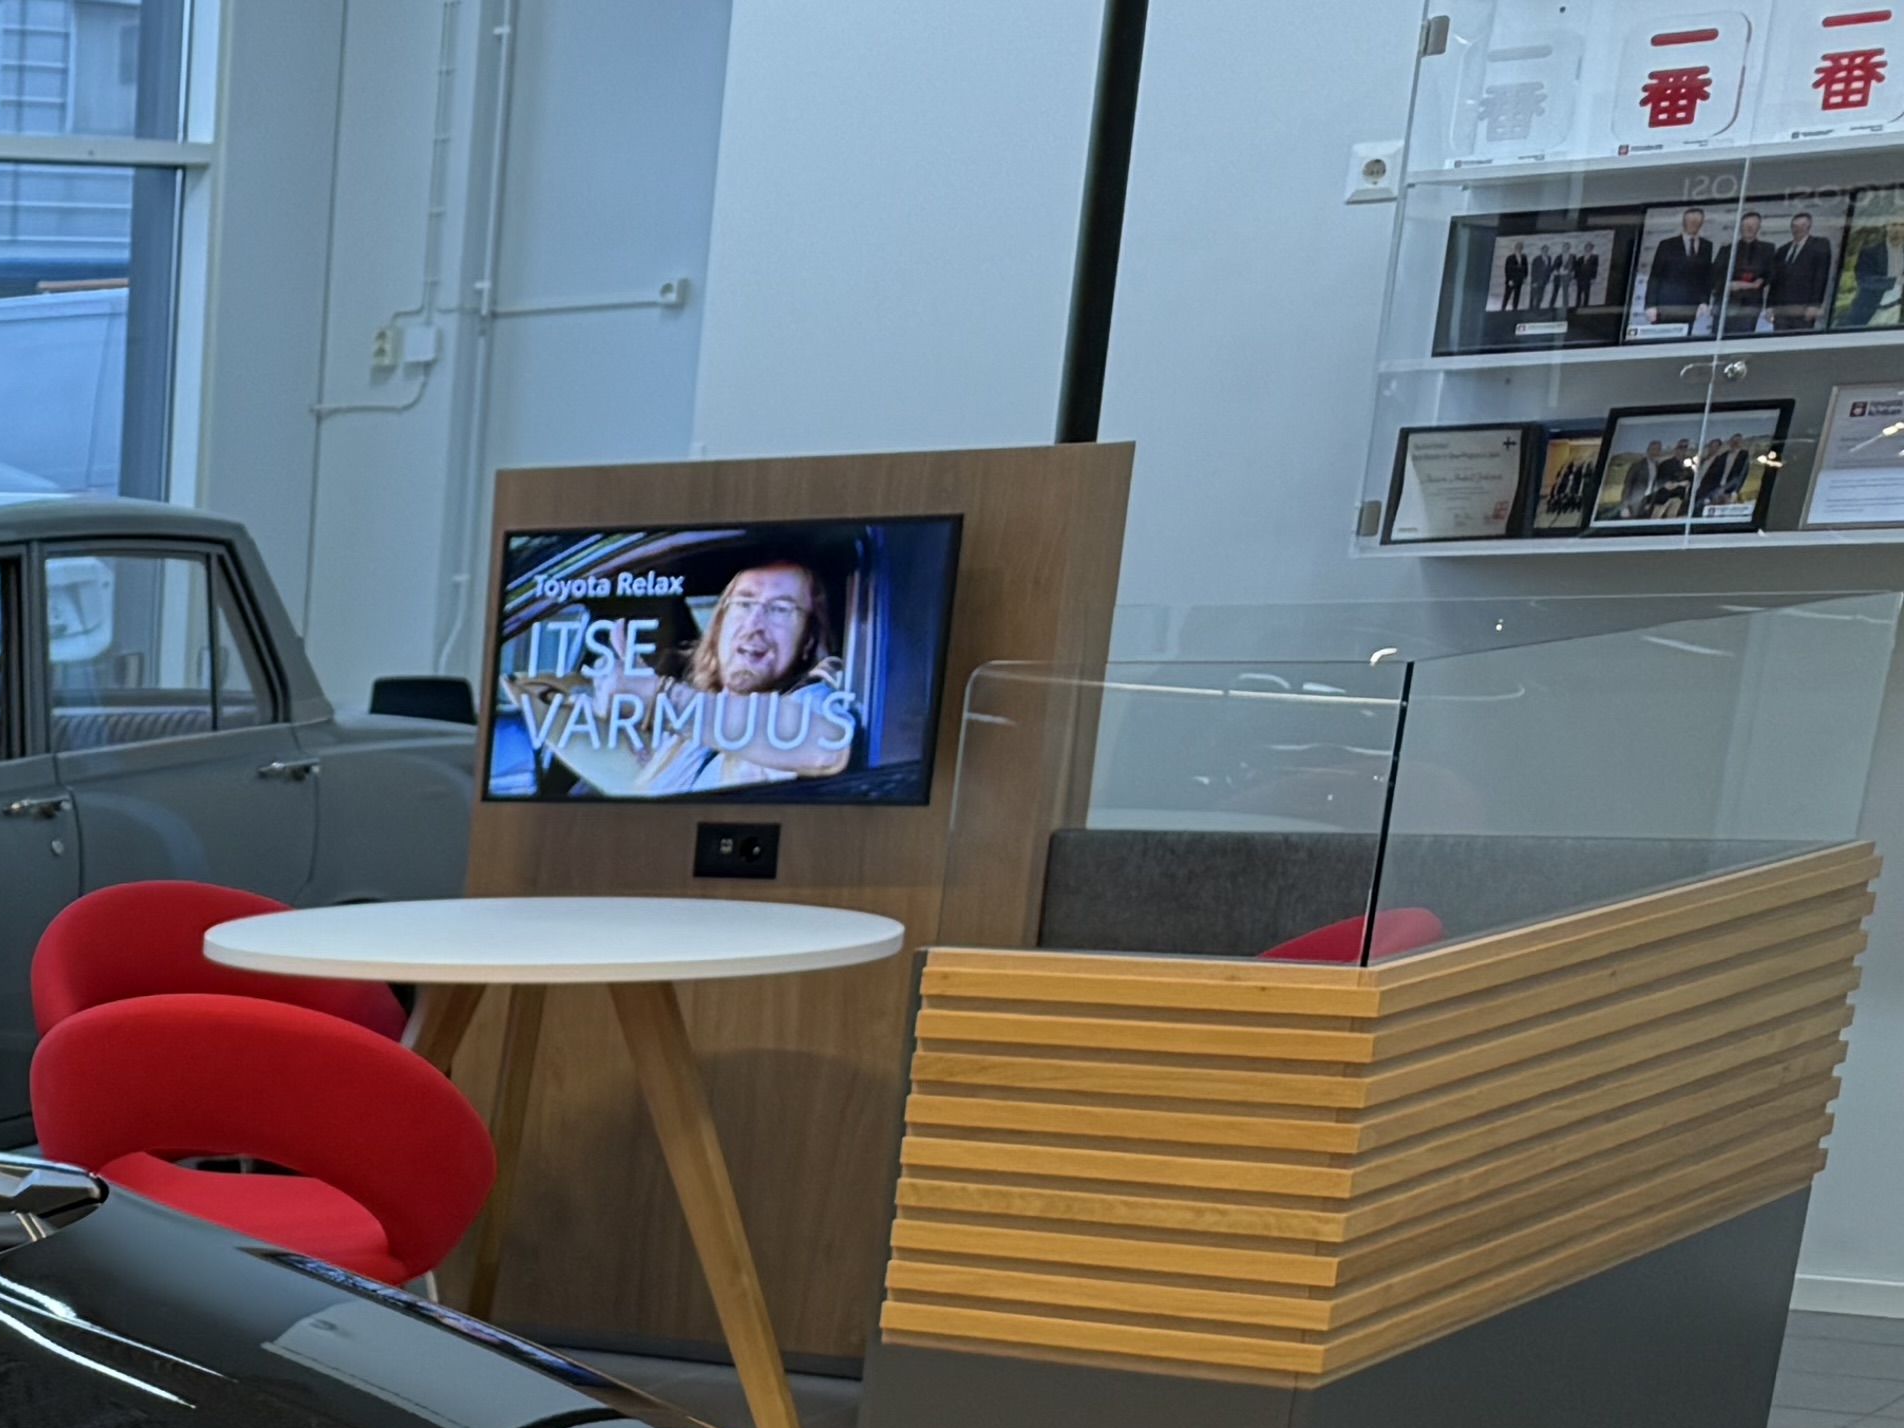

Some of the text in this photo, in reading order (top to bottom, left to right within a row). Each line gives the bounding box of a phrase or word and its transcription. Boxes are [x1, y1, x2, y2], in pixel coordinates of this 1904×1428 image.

[534, 570, 685, 600] Toyota Relax
[527, 618, 660, 679] ITSE
[520, 690, 857, 750] VARMUUS
